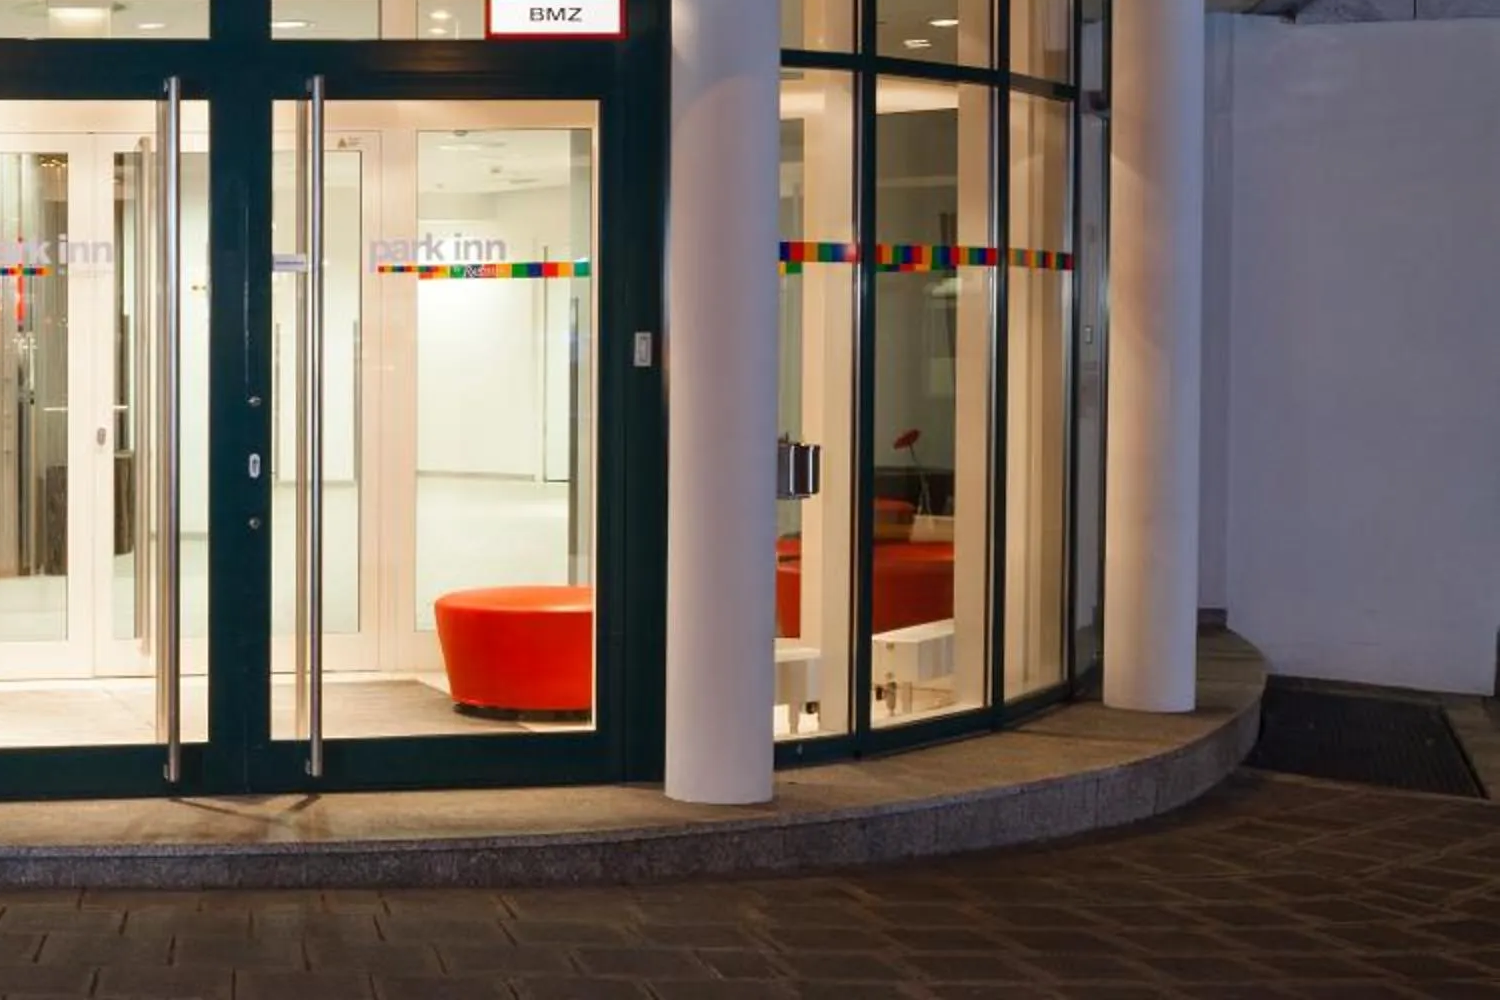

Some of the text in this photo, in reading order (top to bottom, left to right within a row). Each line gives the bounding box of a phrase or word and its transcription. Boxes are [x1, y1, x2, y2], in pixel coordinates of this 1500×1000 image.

[529, 7, 582, 22] BMZ
[58, 233, 112, 264] inn
[369, 233, 445, 273] park
[454, 233, 507, 262] inn
